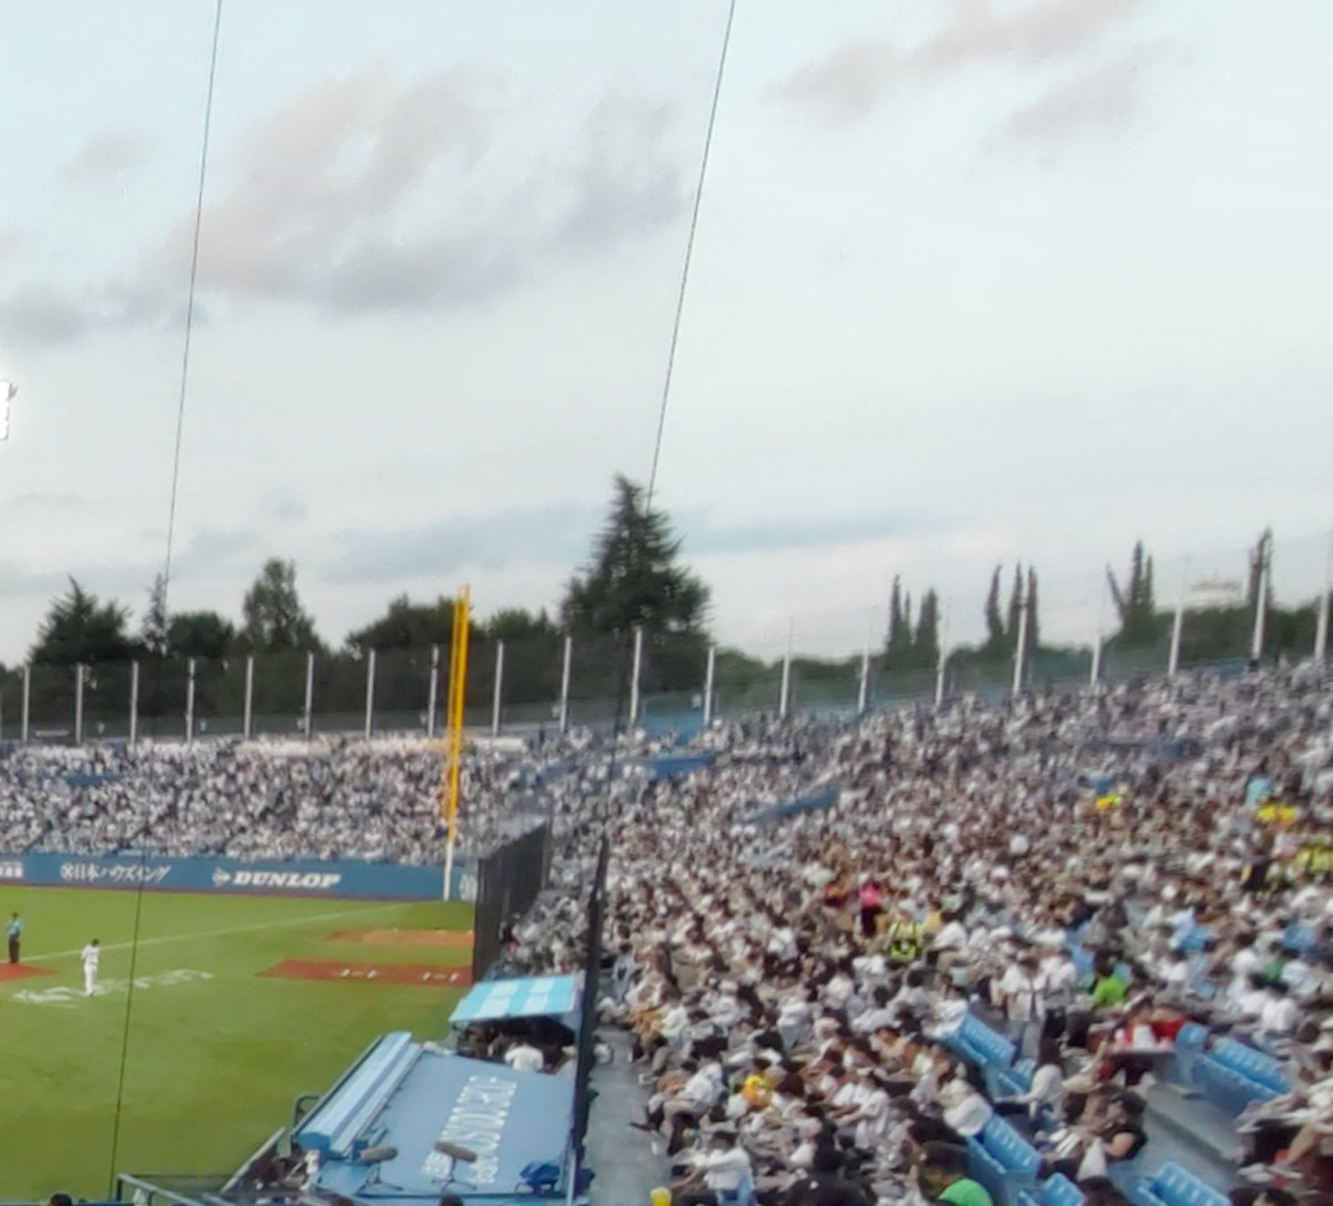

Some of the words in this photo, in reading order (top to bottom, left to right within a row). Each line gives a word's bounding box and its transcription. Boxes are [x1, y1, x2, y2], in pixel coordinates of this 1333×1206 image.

[74, 863, 172, 883] 日本ハウズイング
[233, 872, 341, 888] DUNLOP
